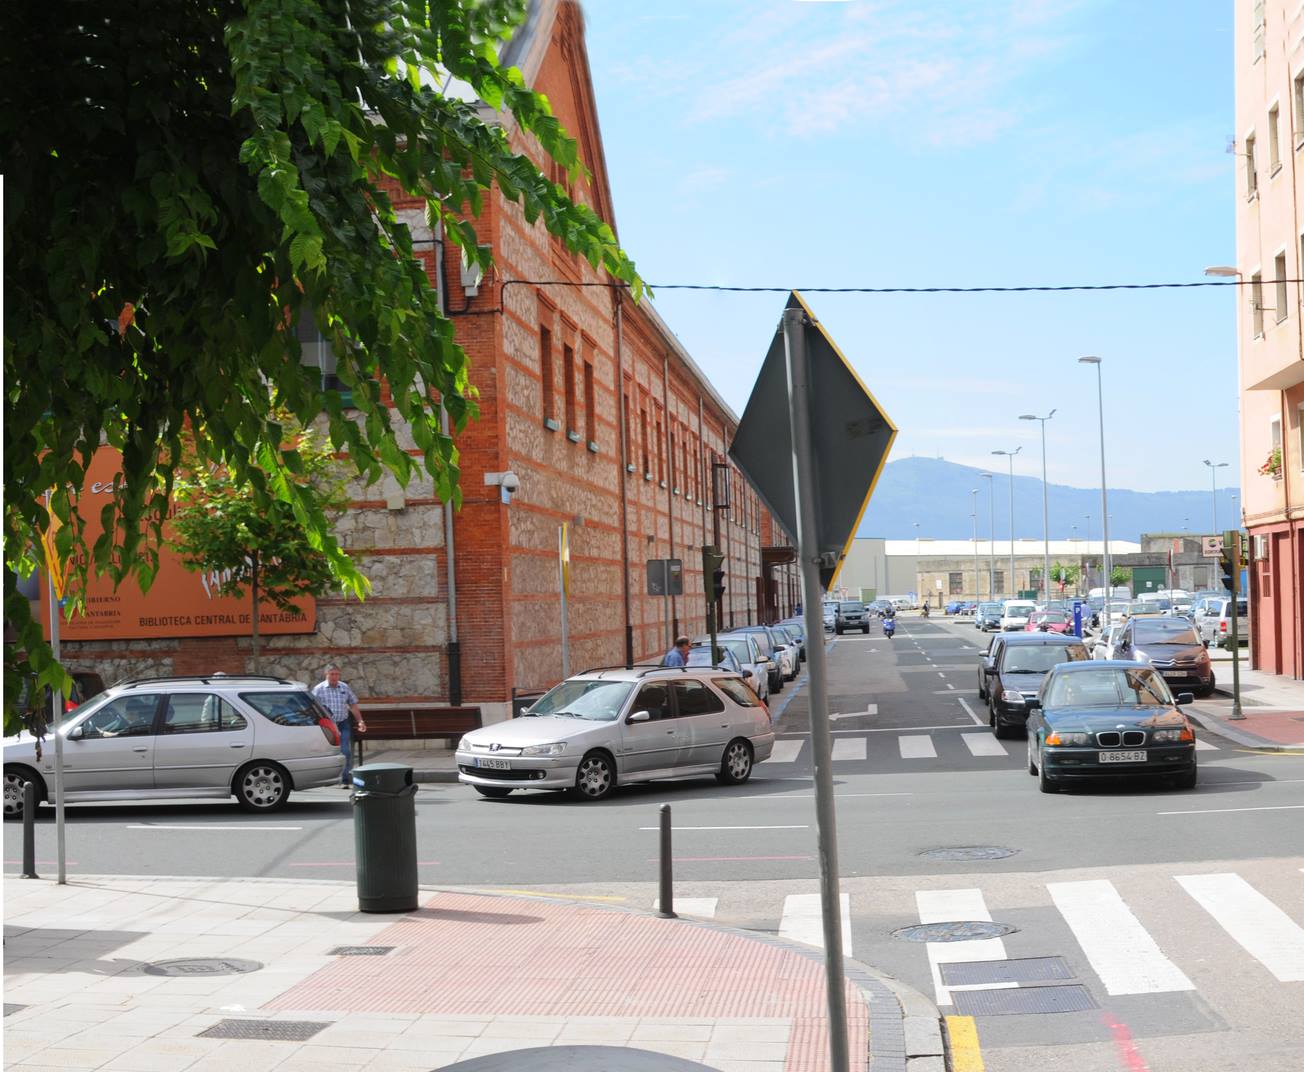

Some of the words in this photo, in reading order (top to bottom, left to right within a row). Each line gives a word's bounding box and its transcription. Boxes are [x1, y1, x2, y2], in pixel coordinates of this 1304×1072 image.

[138, 615, 192, 627] BIBLIOTECA
[194, 614, 236, 625] CENTRAL
[239, 613, 250, 624] DE
[253, 612, 307, 624] ANTABRIA
